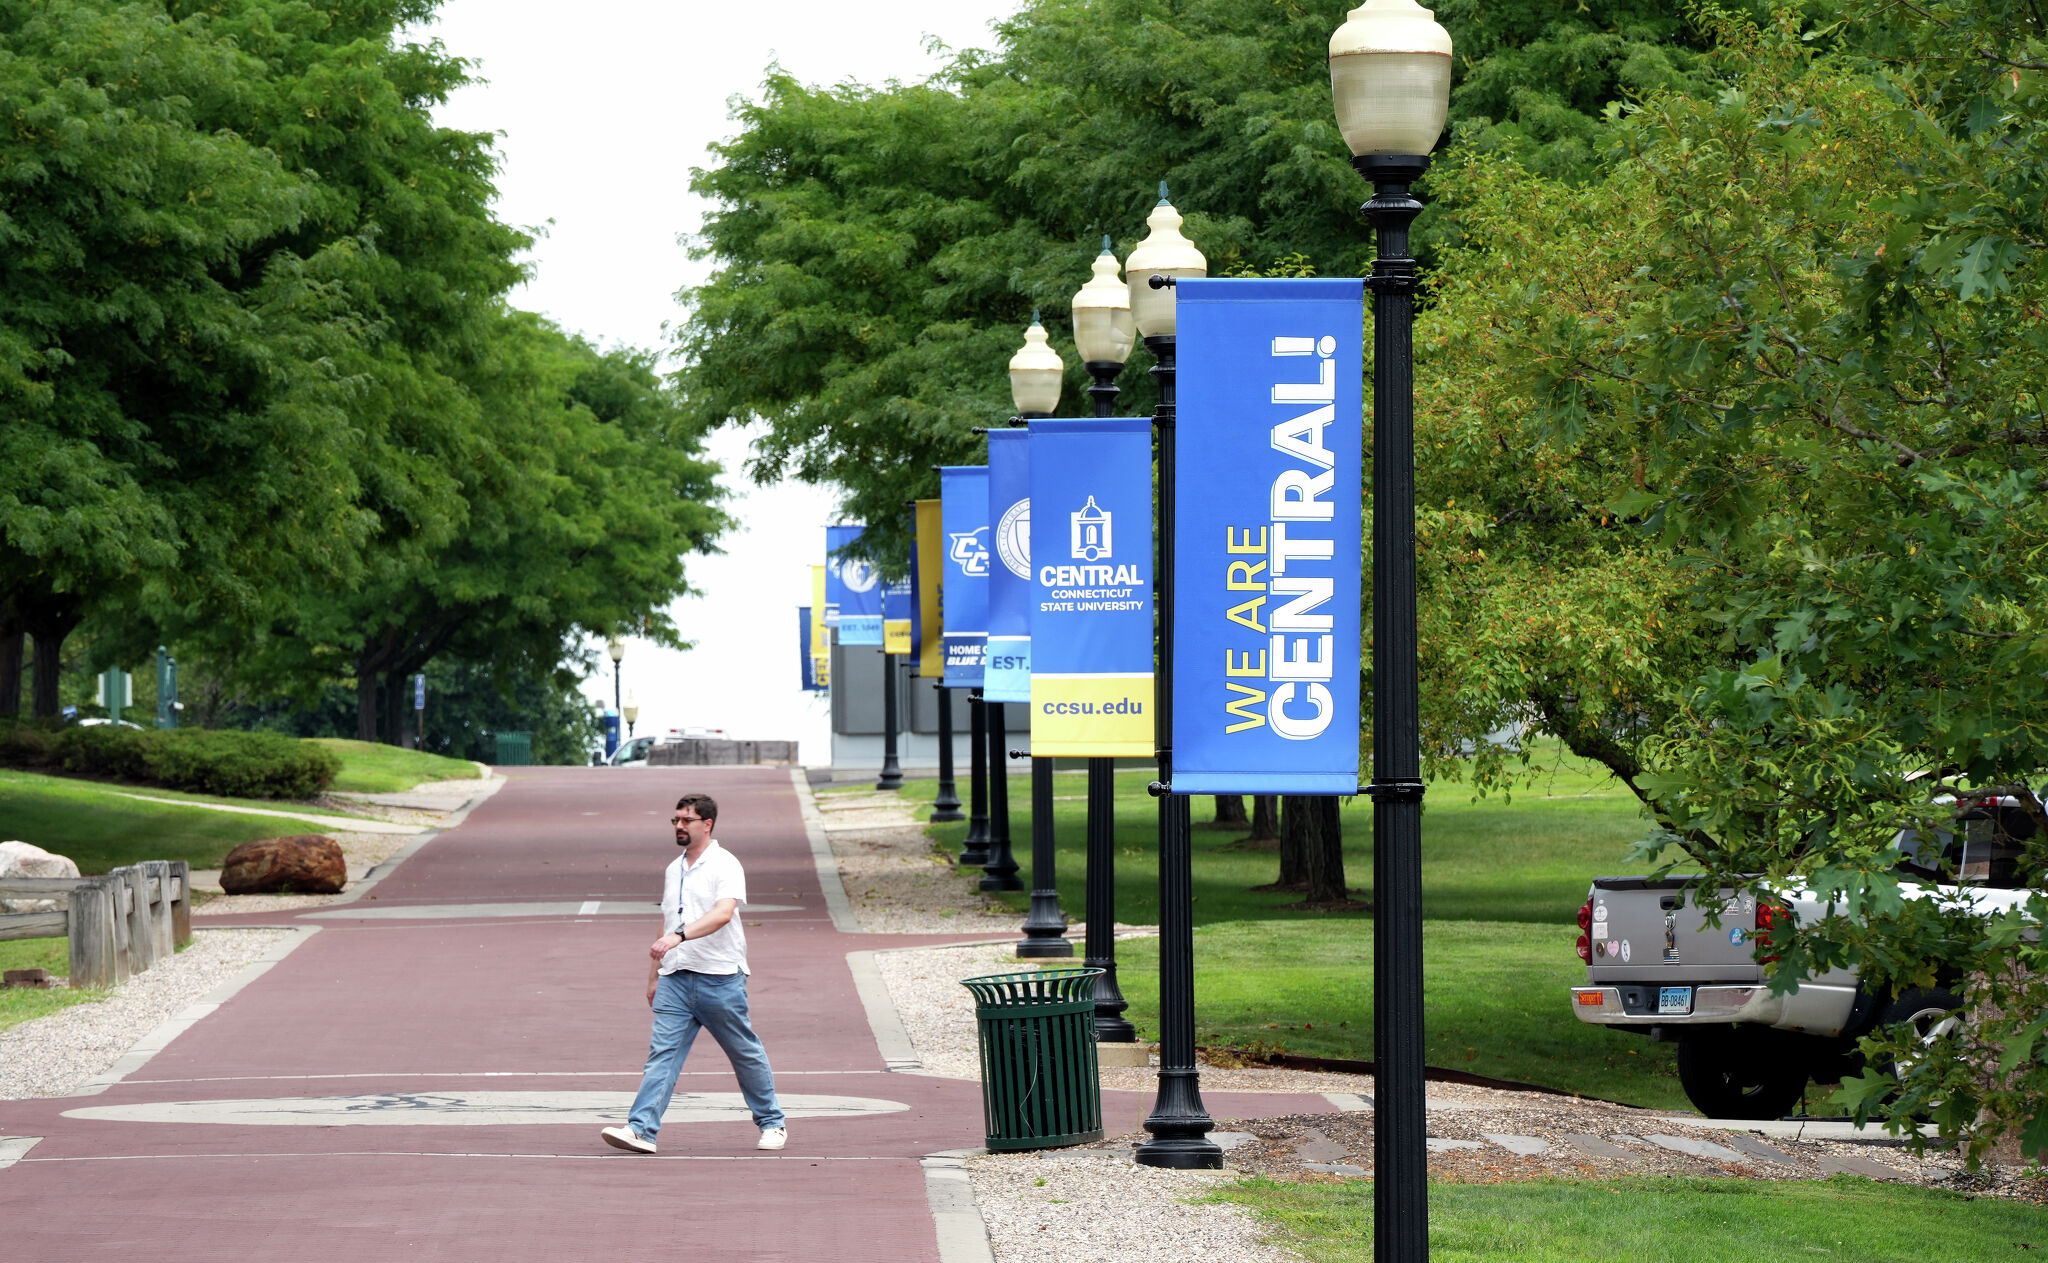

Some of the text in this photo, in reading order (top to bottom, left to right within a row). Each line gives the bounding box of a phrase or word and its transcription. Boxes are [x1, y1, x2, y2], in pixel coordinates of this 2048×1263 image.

[1267, 335, 1337, 741] CENTRAL!
[1040, 564, 1144, 587] CENTRAL
[1051, 588, 1133, 599] CONNECTICUT
[1040, 601, 1144, 612] STATE UNIVERSITY
[1225, 525, 1267, 735] WE ARE
[949, 645, 981, 655] HOME
[946, 656, 979, 666] BLUE
[992, 656, 1030, 670] EST.
[1043, 697, 1143, 715] ccsu.edu
